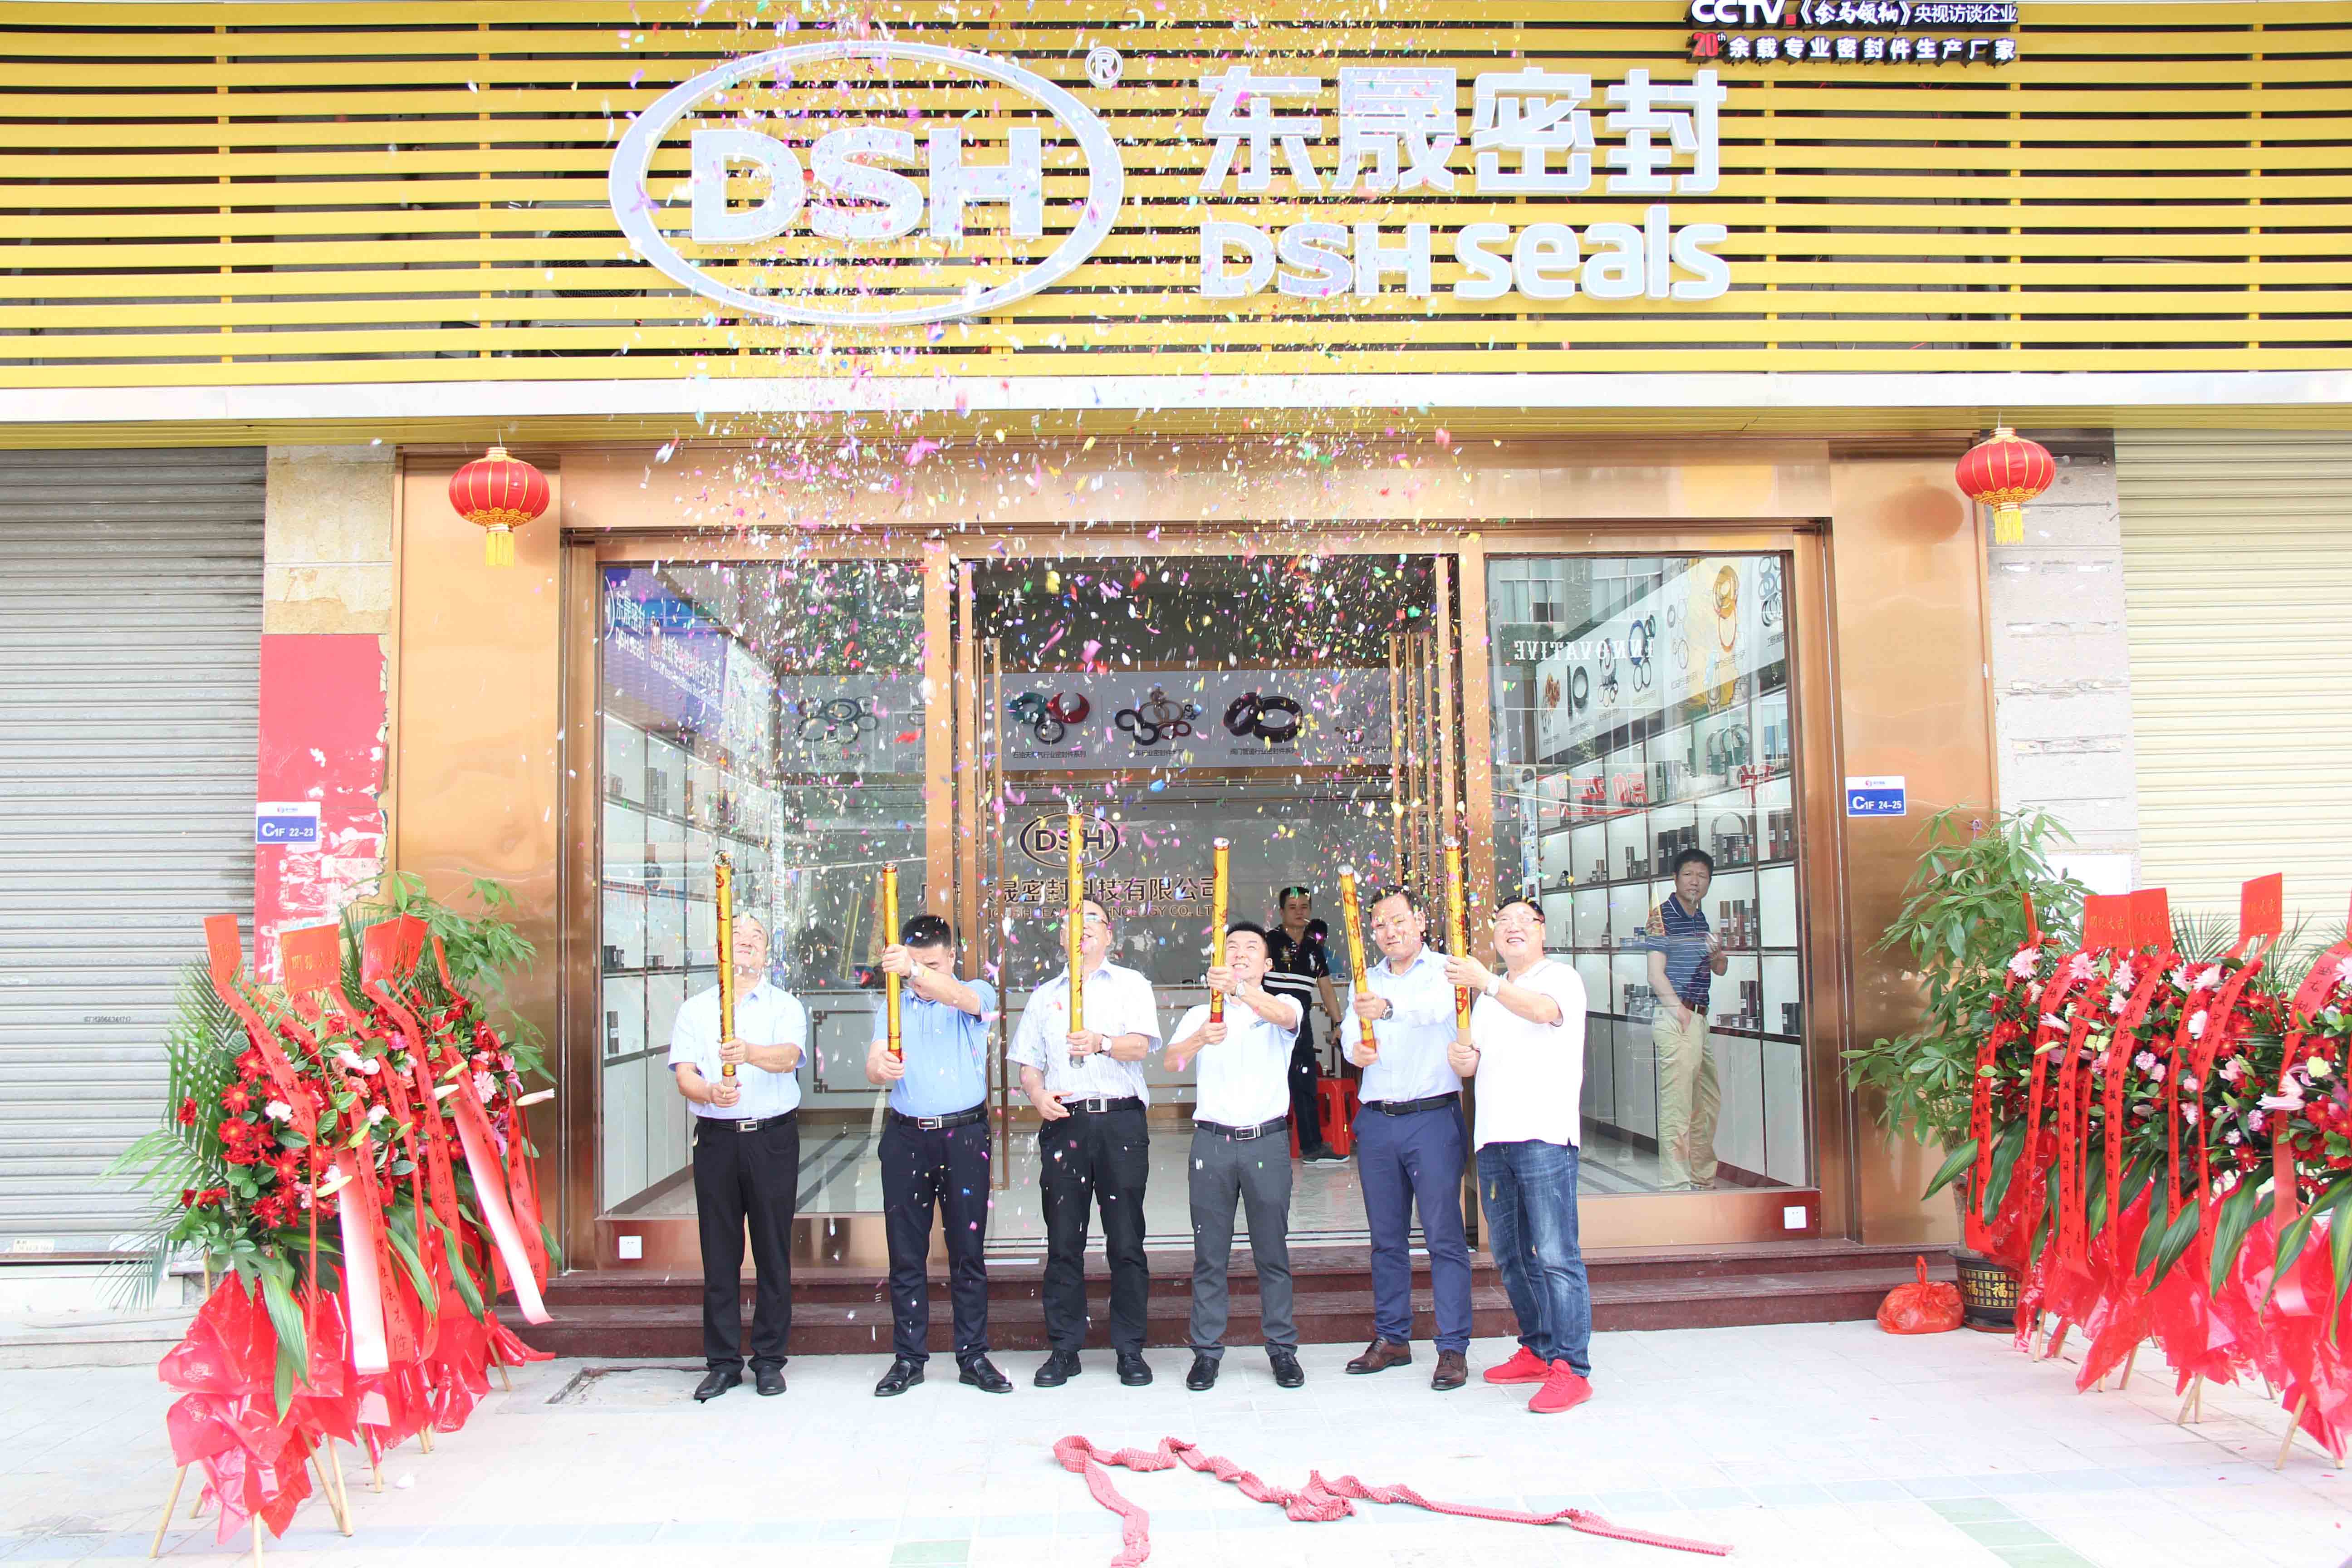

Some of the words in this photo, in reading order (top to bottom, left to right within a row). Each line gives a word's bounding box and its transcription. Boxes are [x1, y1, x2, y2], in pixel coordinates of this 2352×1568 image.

[1691, 0, 1784, 23] CCTV
[1914, 4, 2018, 24] 央视访谈企业
[1729, 36, 2016, 59] 余载专业密封件生产厂家
[1197, 65, 1727, 196] 东晟密封
[691, 126, 1043, 245] DSH
[1199, 221, 1433, 300] DSH
[1453, 204, 1731, 301] seals
[1878, 800, 1902, 809] 24-25
[289, 827, 314, 837] 22-23
